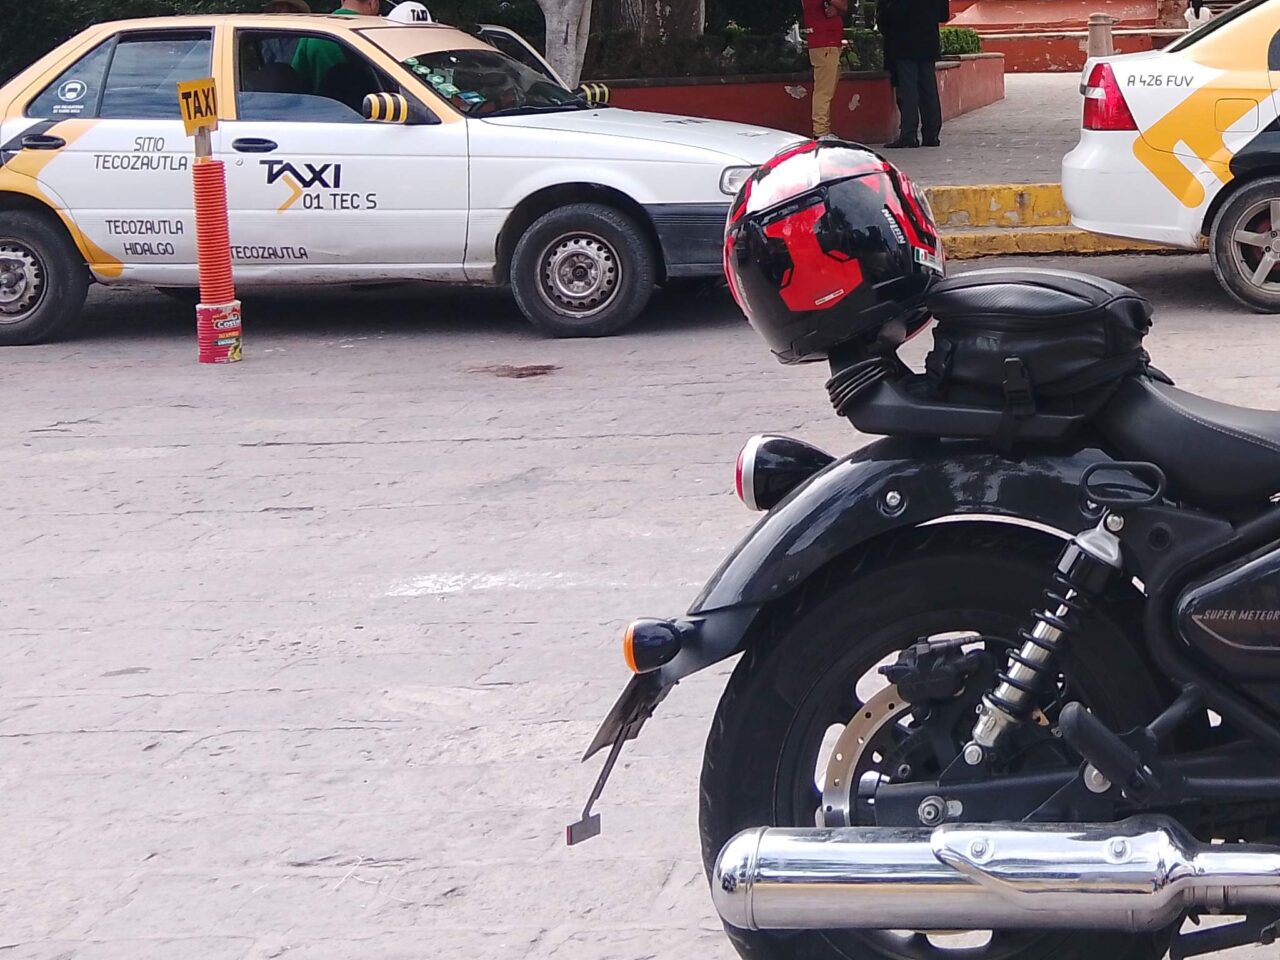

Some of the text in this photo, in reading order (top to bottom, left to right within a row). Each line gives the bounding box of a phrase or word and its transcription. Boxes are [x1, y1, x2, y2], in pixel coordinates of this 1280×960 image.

[411, 9, 427, 22] TAXI
[1127, 74, 1194, 87] A 426 FUV
[182, 90, 216, 119] TAXI
[134, 136, 165, 152] SITIO
[94, 155, 188, 171] TECOZAUTLA
[260, 160, 341, 189] TAXI
[303, 193, 377, 210] 01 TEC S
[106, 219, 183, 235] TECOZAUTLA
[123, 242, 174, 256] HIDALGO
[230, 245, 309, 260] TECOZAUTLA
[1203, 609, 1236, 620] SUPER
[1238, 609, 1280, 621] METEOR
